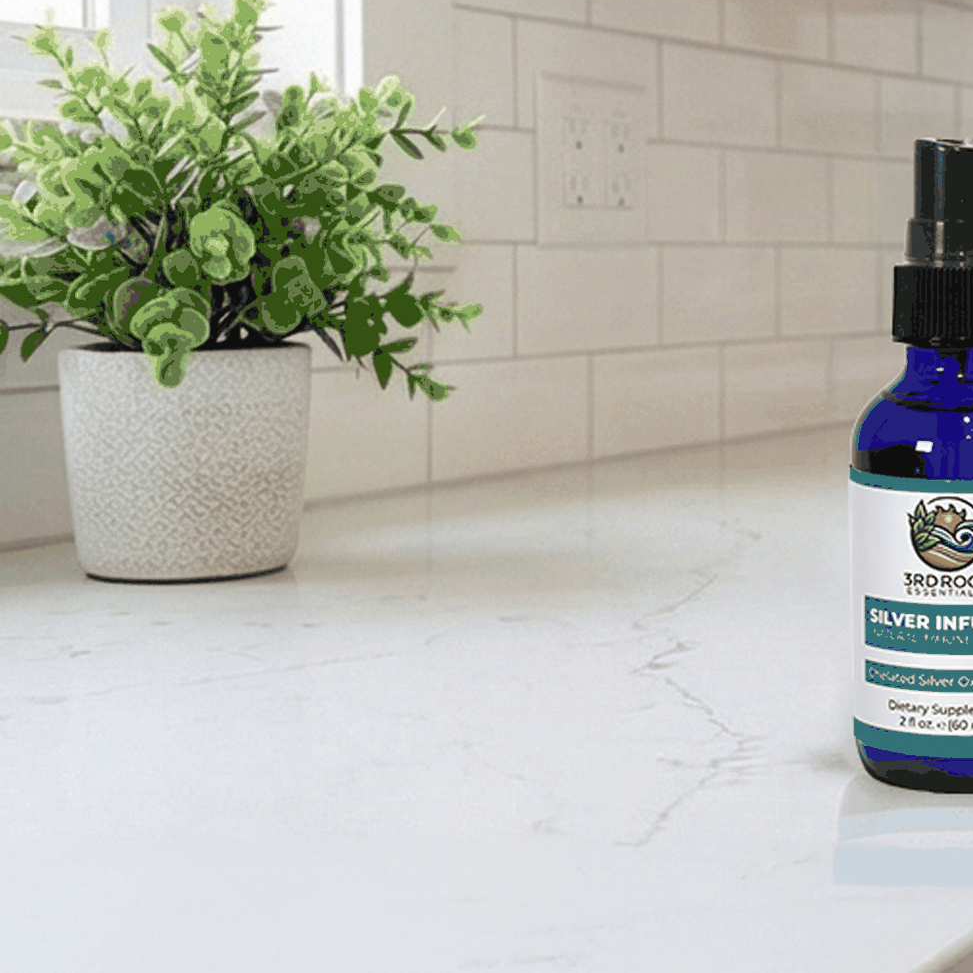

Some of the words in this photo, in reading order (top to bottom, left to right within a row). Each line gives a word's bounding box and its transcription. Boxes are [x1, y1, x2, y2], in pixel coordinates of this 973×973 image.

[869, 607, 930, 630] SILVER
[888, 699, 929, 716] Dietary
[899, 716, 907, 727] 2
